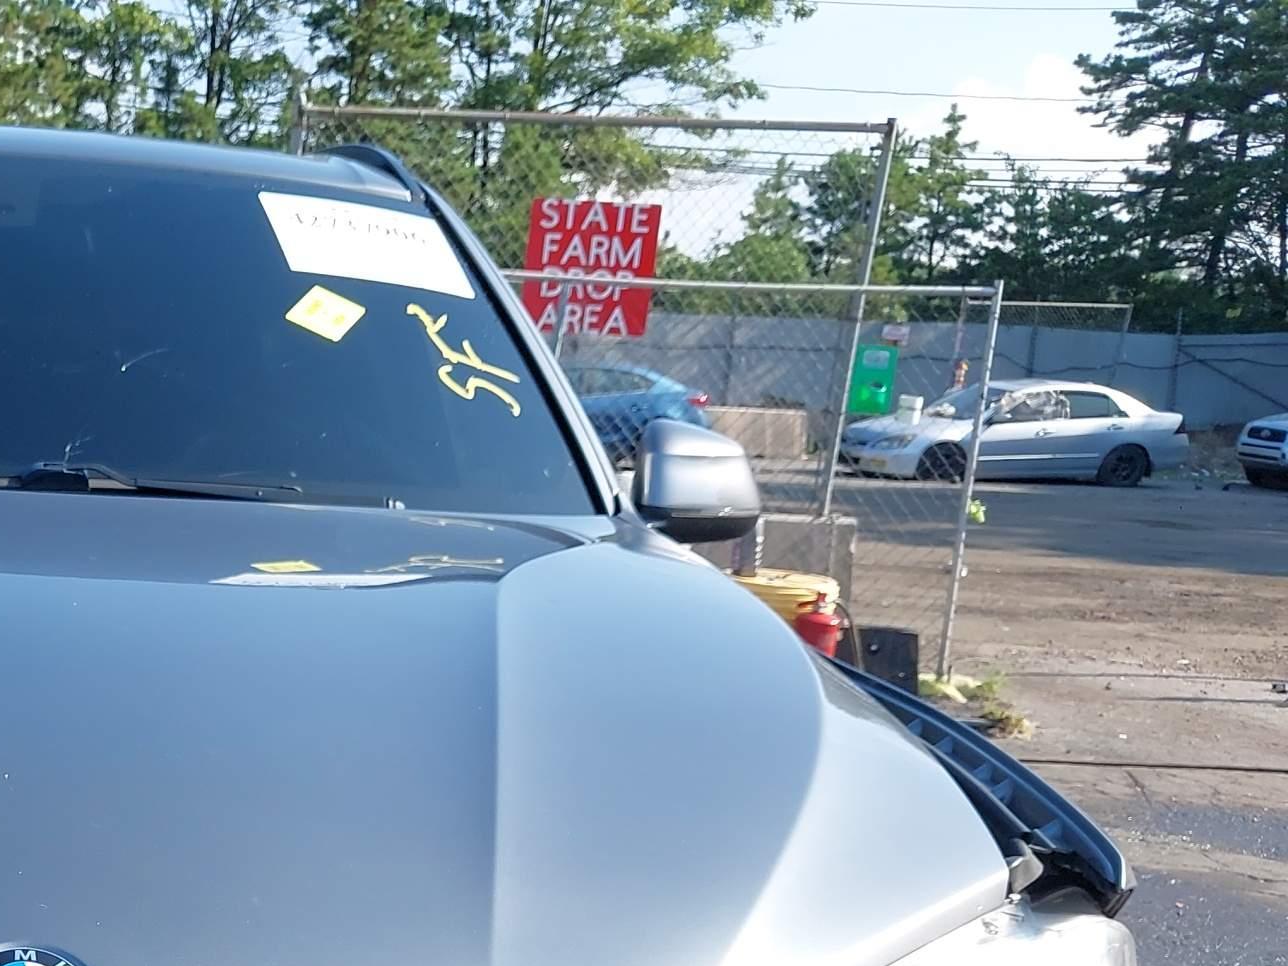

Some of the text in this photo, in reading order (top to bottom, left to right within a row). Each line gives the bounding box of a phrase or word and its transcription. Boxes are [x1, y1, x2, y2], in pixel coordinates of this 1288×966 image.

[539, 198, 650, 233] STATE
[541, 231, 643, 269] FARM
[539, 265, 635, 302] DROP
[537, 302, 628, 336] AREA
